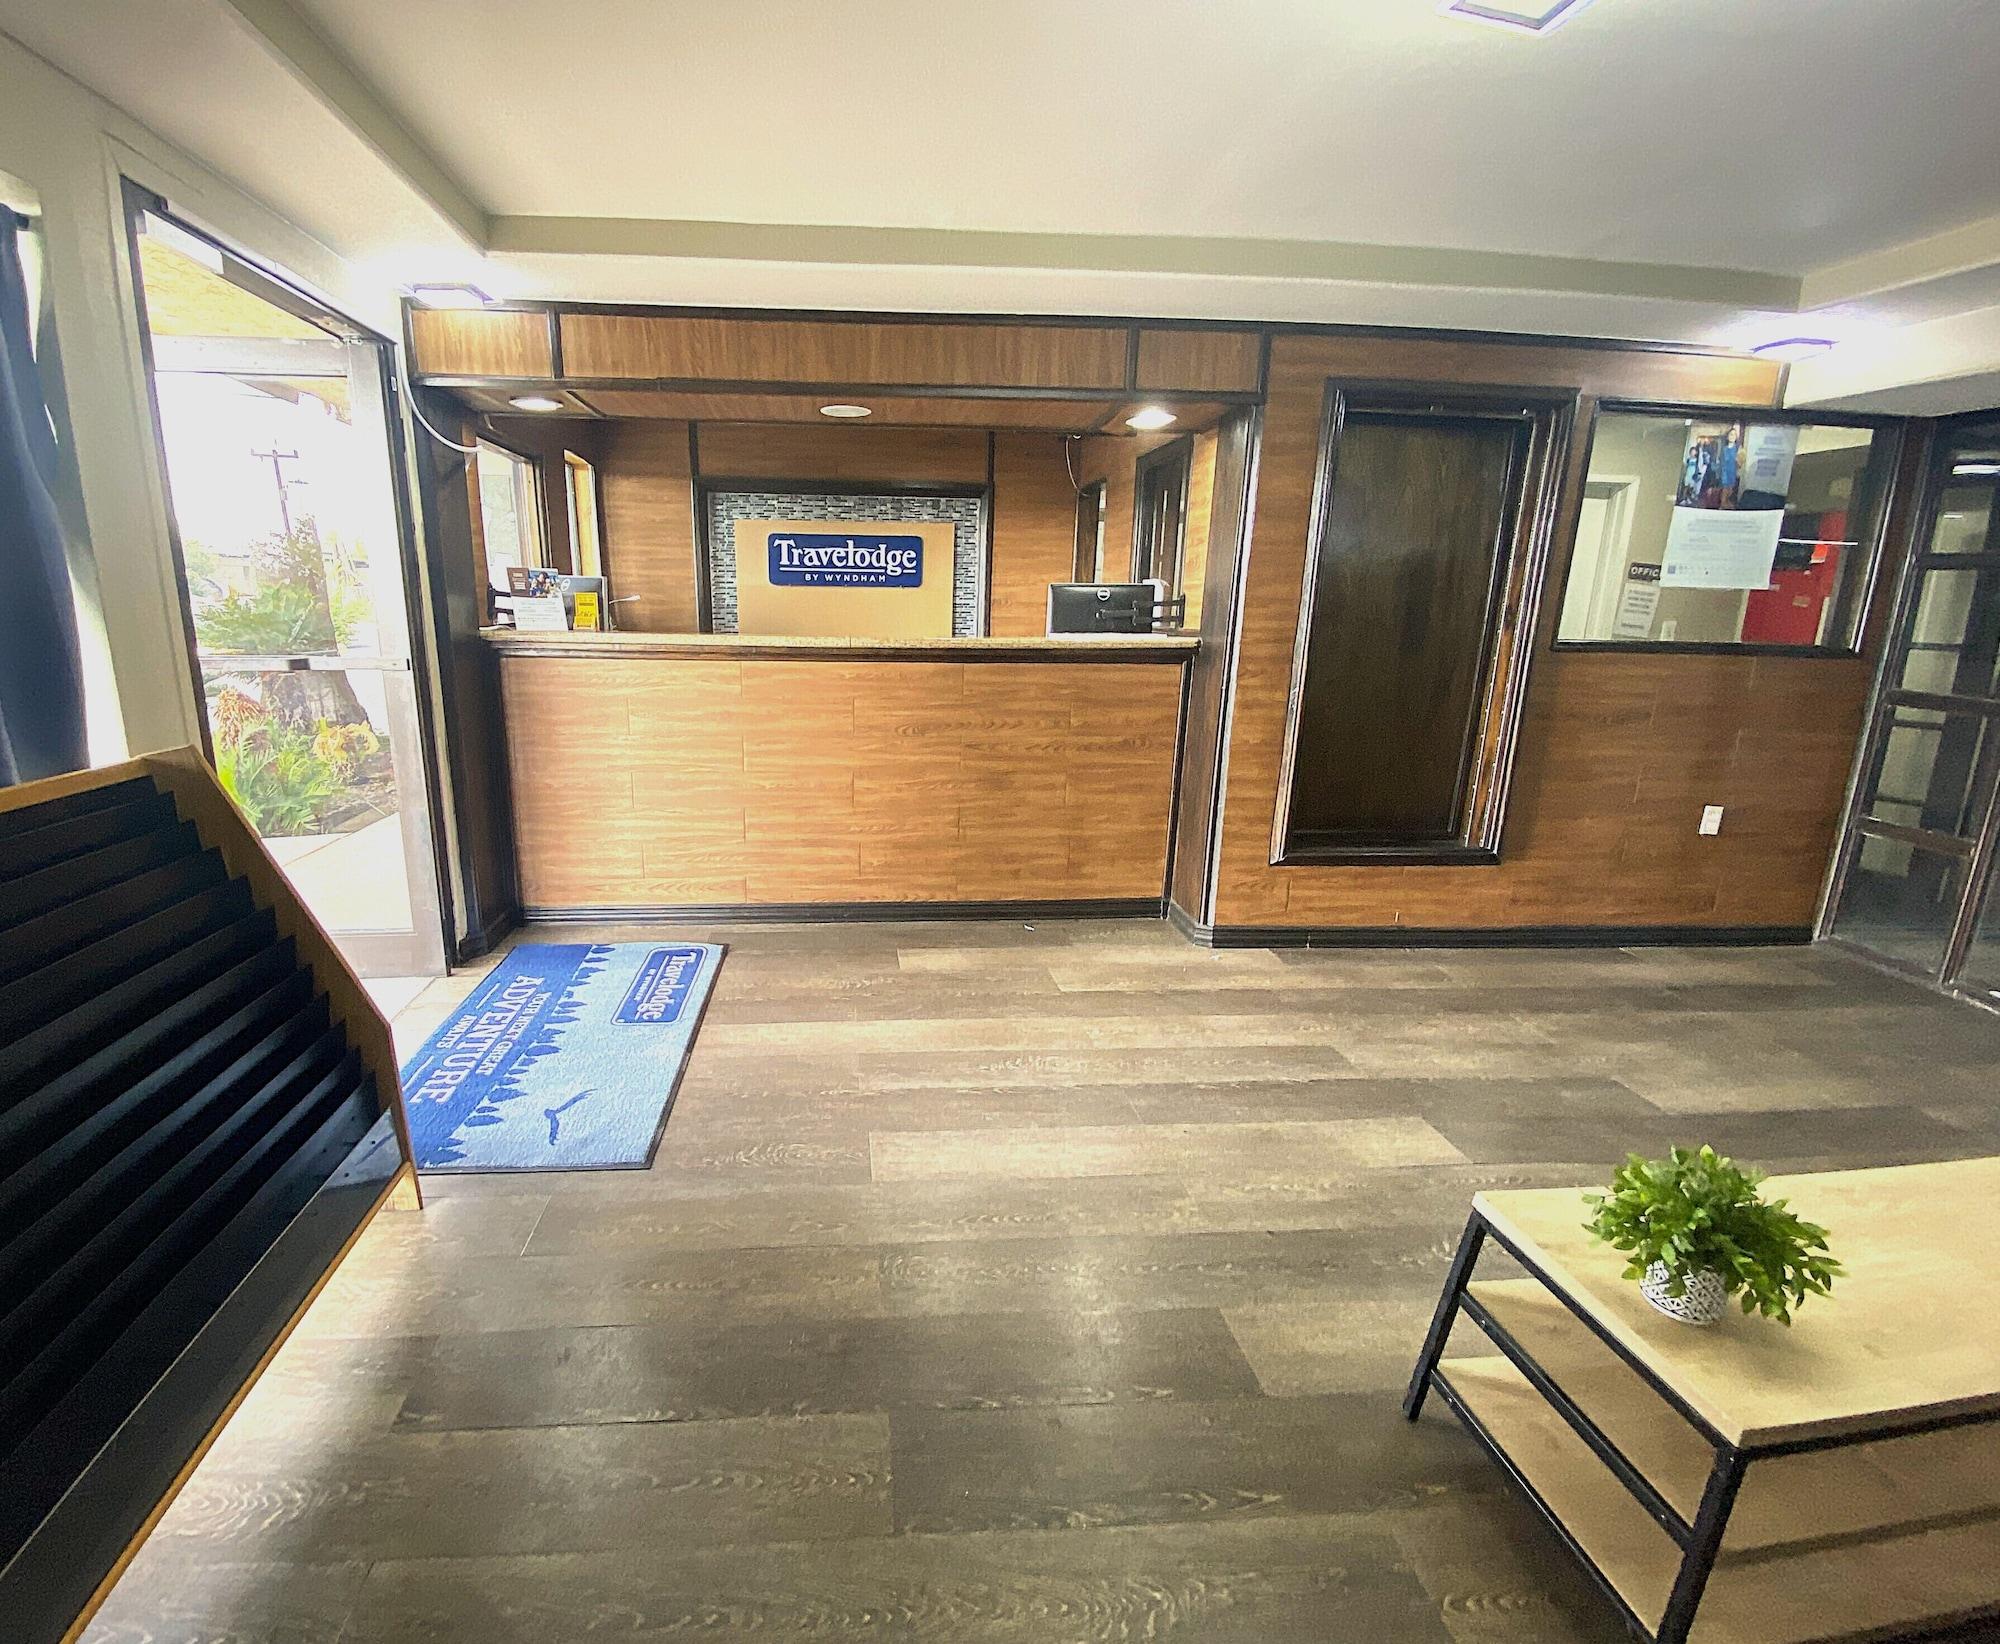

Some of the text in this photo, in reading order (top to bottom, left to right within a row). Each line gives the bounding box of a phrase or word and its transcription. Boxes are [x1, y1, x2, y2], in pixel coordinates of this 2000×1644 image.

[773, 538, 917, 576] Travelodge
[1631, 566, 1660, 577] OFFIC
[805, 573, 886, 582] BY WYNDHAM
[637, 951, 696, 1020] Travelodge
[409, 976, 544, 1104] ADVENTURE
[436, 1015, 477, 1050] AWAITS
[475, 991, 552, 1075] YOUR NEXT GREAT
